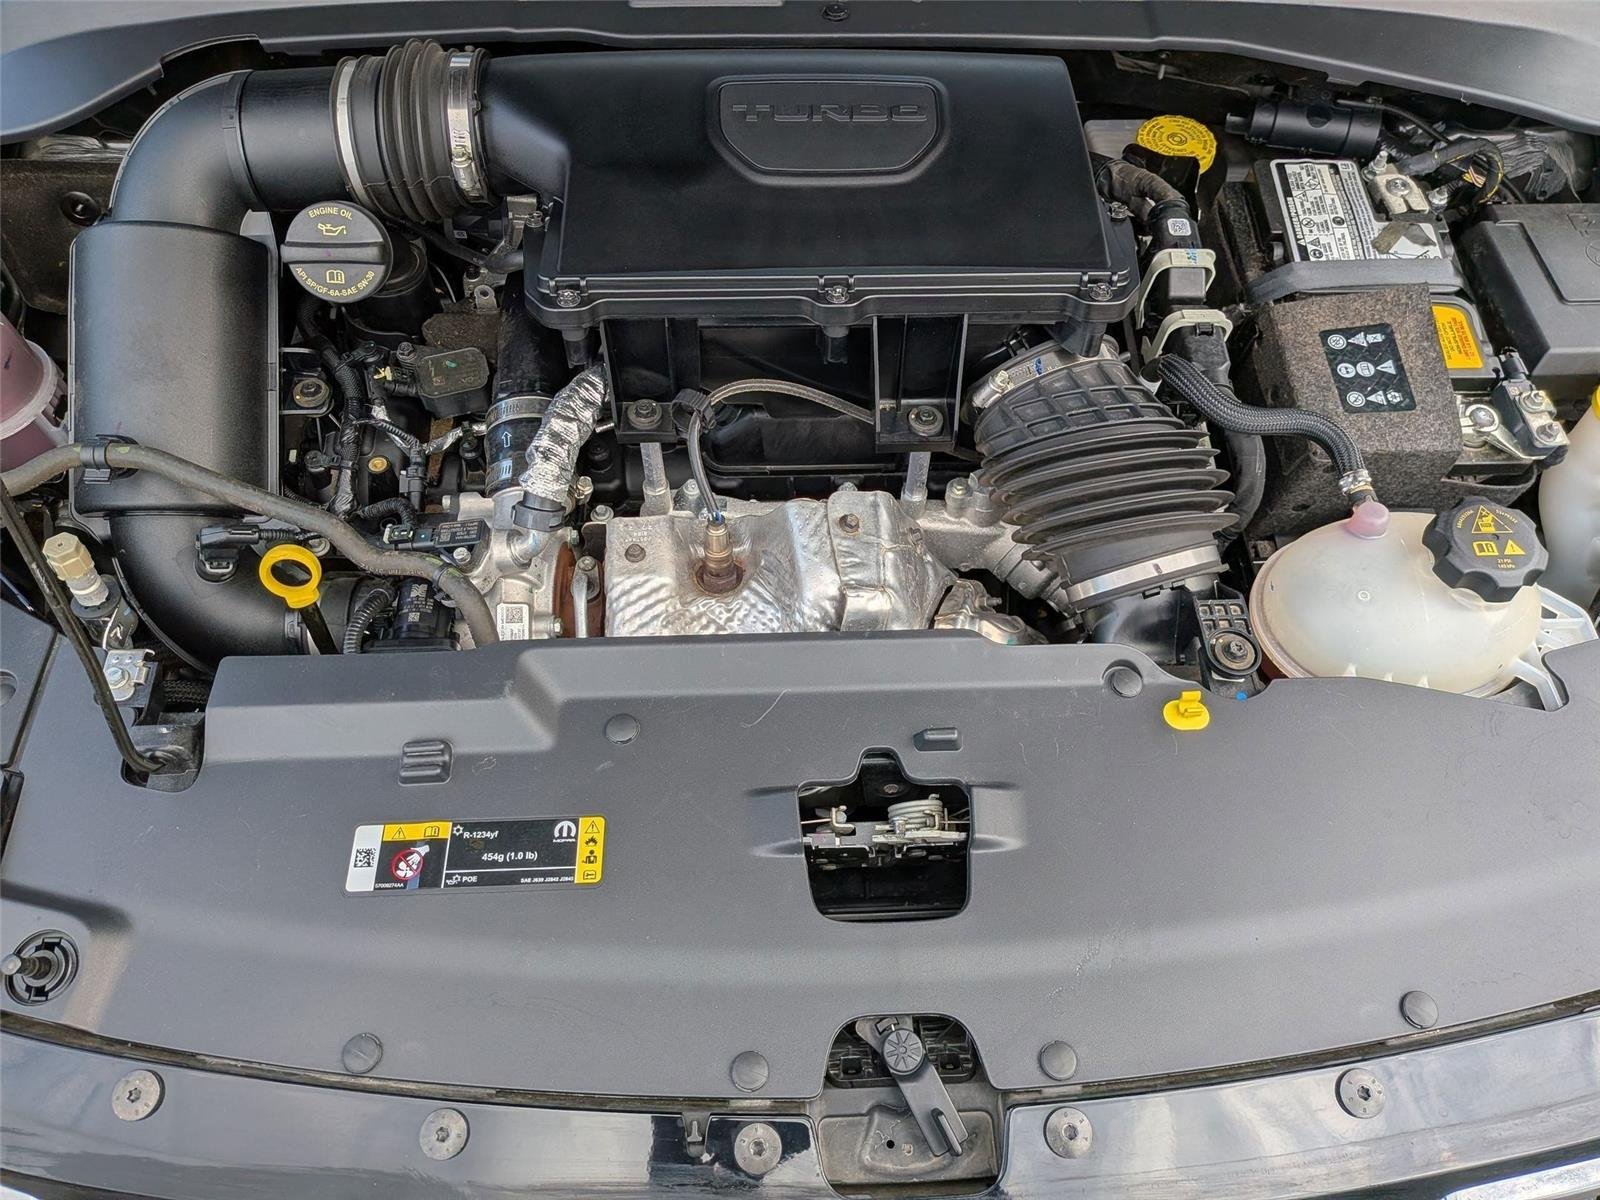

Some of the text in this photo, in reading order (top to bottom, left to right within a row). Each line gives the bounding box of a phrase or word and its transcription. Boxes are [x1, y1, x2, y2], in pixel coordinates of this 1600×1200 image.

[732, 103, 928, 122] TURBO
[308, 207, 353, 220] ENGINE OIL
[296, 267, 308, 280] API
[463, 830, 499, 840] R-1234yf
[481, 851, 538, 863] 454g (1.0 lb)
[462, 875, 478, 883] POE
